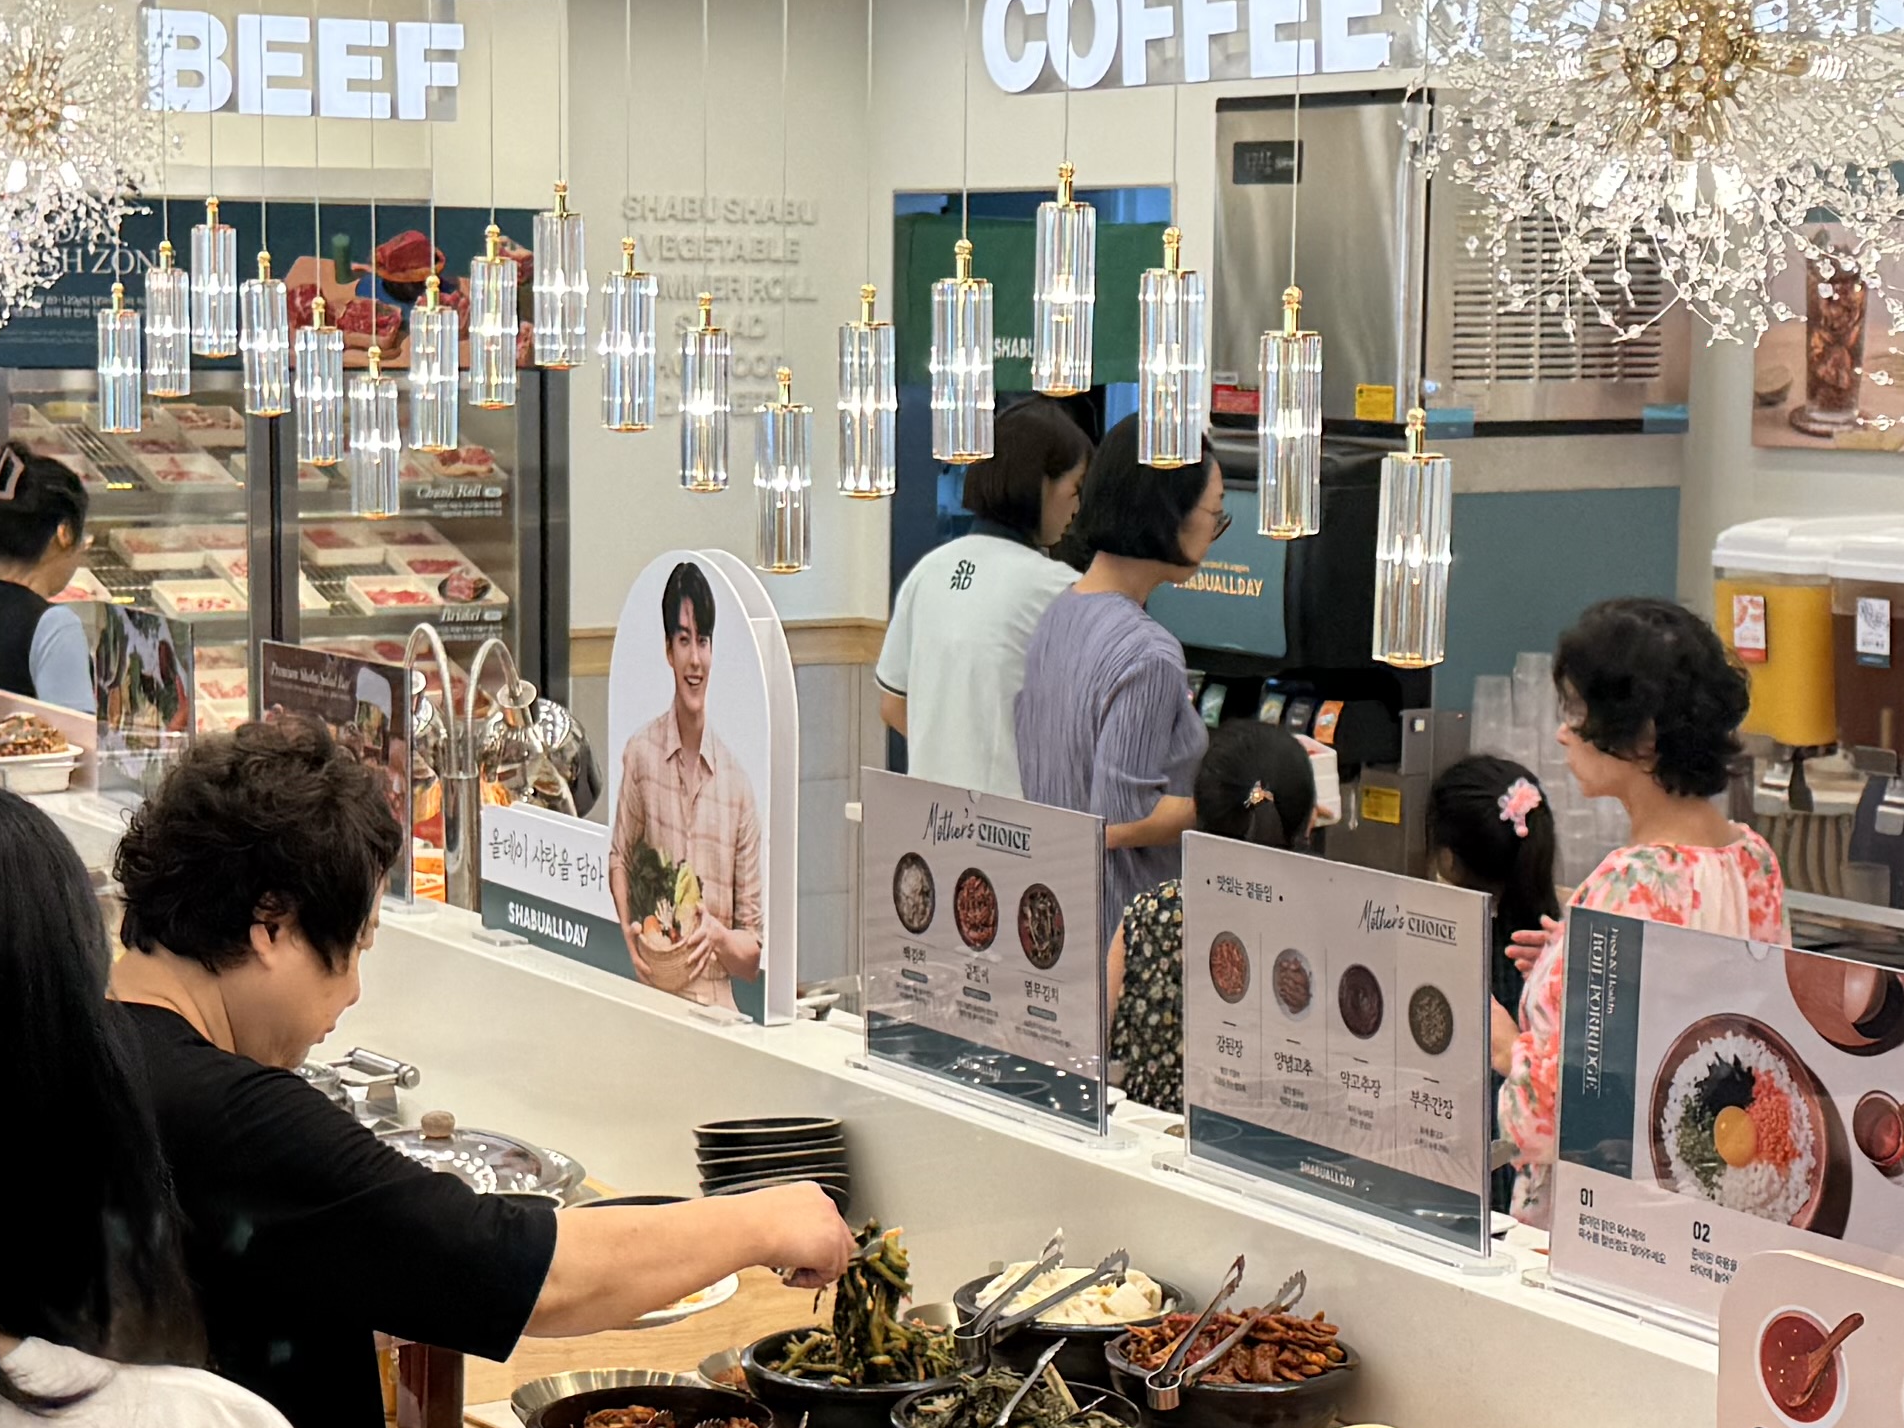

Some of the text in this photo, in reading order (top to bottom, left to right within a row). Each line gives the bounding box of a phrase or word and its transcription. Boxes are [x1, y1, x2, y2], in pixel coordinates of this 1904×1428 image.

[145, 8, 465, 120] BEEF
[622, 195, 819, 225] SHABU SHABU
[640, 233, 801, 264] VEGETABLE
[923, 801, 1031, 852] Mother's CHOICE
[532, 838, 573, 881] 사랑을
[577, 852, 604, 892] 담아
[507, 901, 589, 948] SHABUALLDAY
[1358, 899, 1457, 941] Mother's CHOICE
[1024, 979, 1060, 1004] 열무김치
[1216, 1035, 1244, 1059] 강된장
[1585, 983, 1603, 1091] PORRIDGE
[1274, 1051, 1314, 1077] 양념고추
[1340, 1070, 1382, 1099] 약고추장
[1409, 1089, 1454, 1120] 부추간장
[1299, 1159, 1356, 1189] SHABUALLDAY
[1580, 1187, 1594, 1208] 01
[1692, 1220, 1711, 1244] 02
